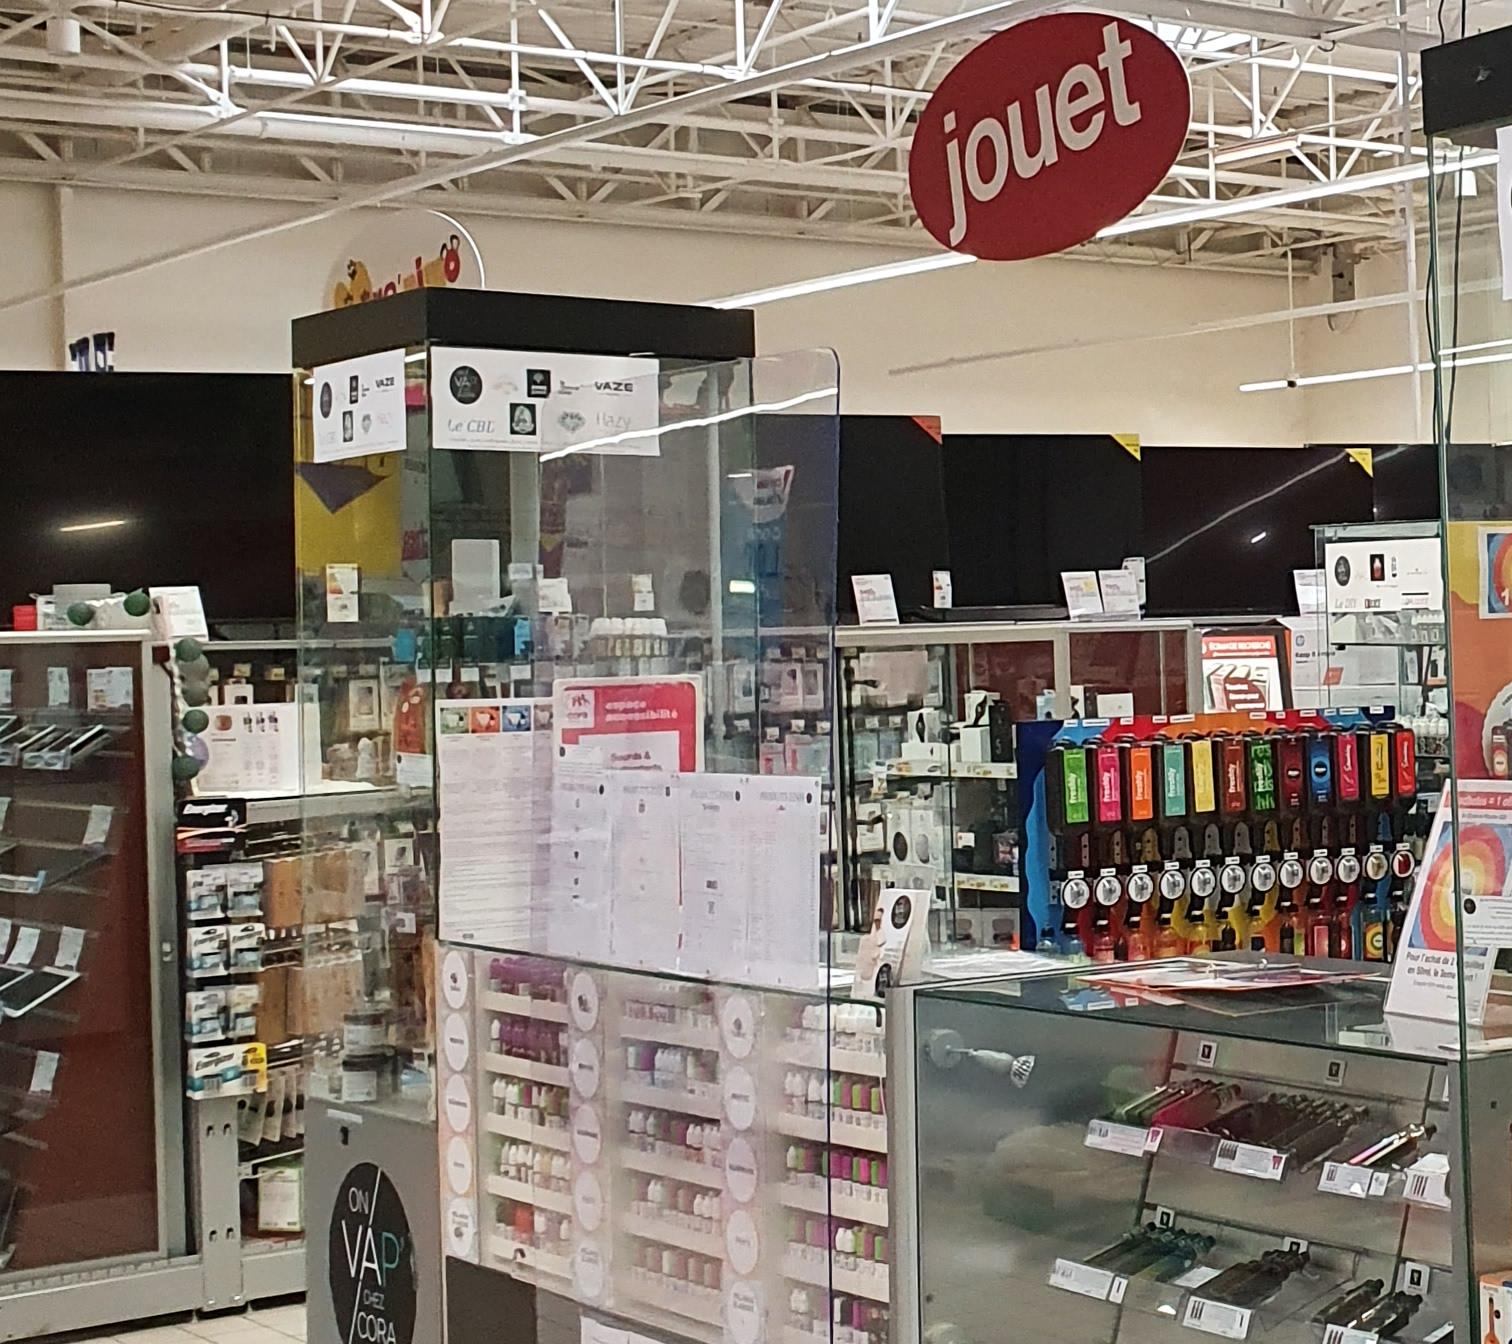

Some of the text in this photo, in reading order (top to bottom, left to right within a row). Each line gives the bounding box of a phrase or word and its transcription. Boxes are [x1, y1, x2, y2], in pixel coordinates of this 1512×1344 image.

[942, 21, 1142, 248] jouet
[594, 380, 634, 393] VAZE
[1406, 951, 1420, 962] Pour
[348, 1186, 370, 1216] ON
[363, 1288, 385, 1311] CHEZ
